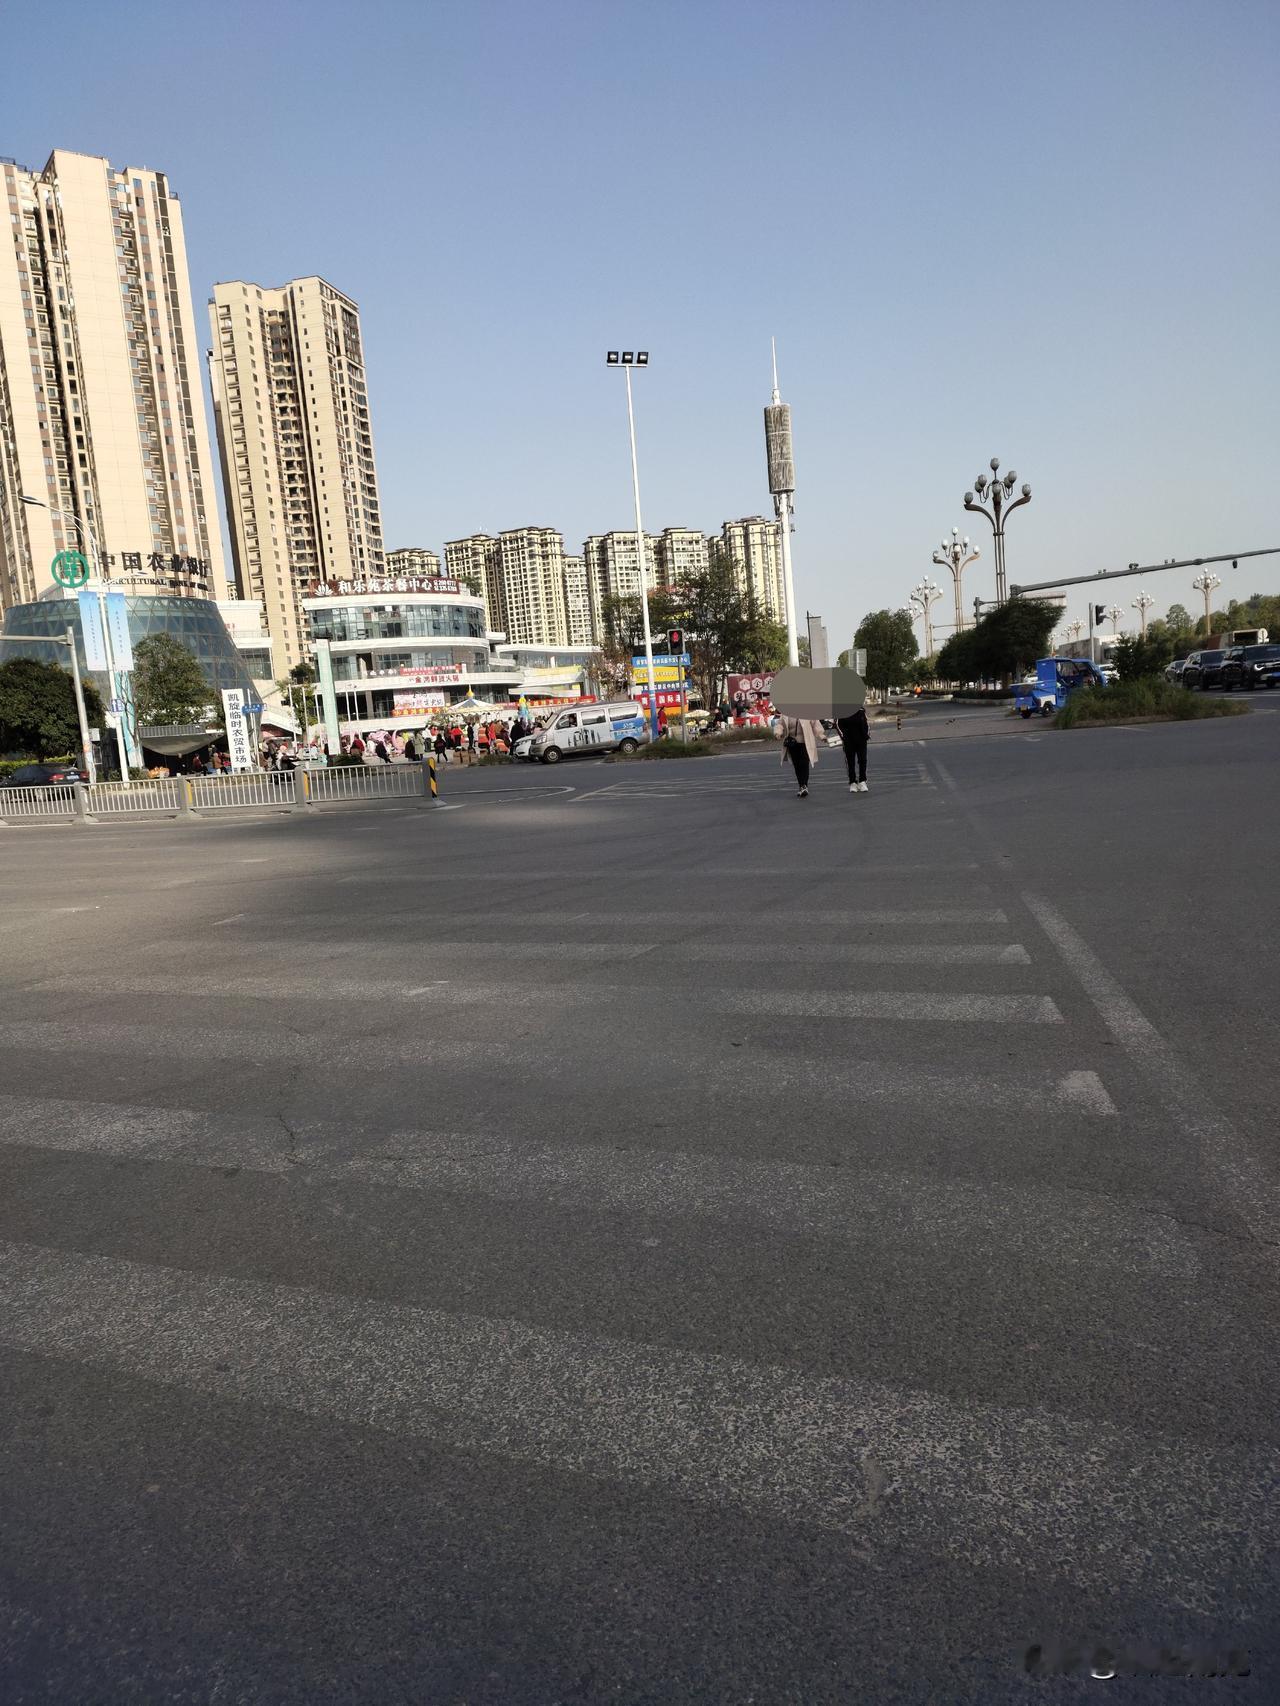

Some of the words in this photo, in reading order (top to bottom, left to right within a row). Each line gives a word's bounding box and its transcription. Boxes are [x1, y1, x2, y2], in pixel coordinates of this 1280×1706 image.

[99, 551, 208, 578] 中国农业银行
[228, 694, 247, 763] 凯旋临时农贸市场
